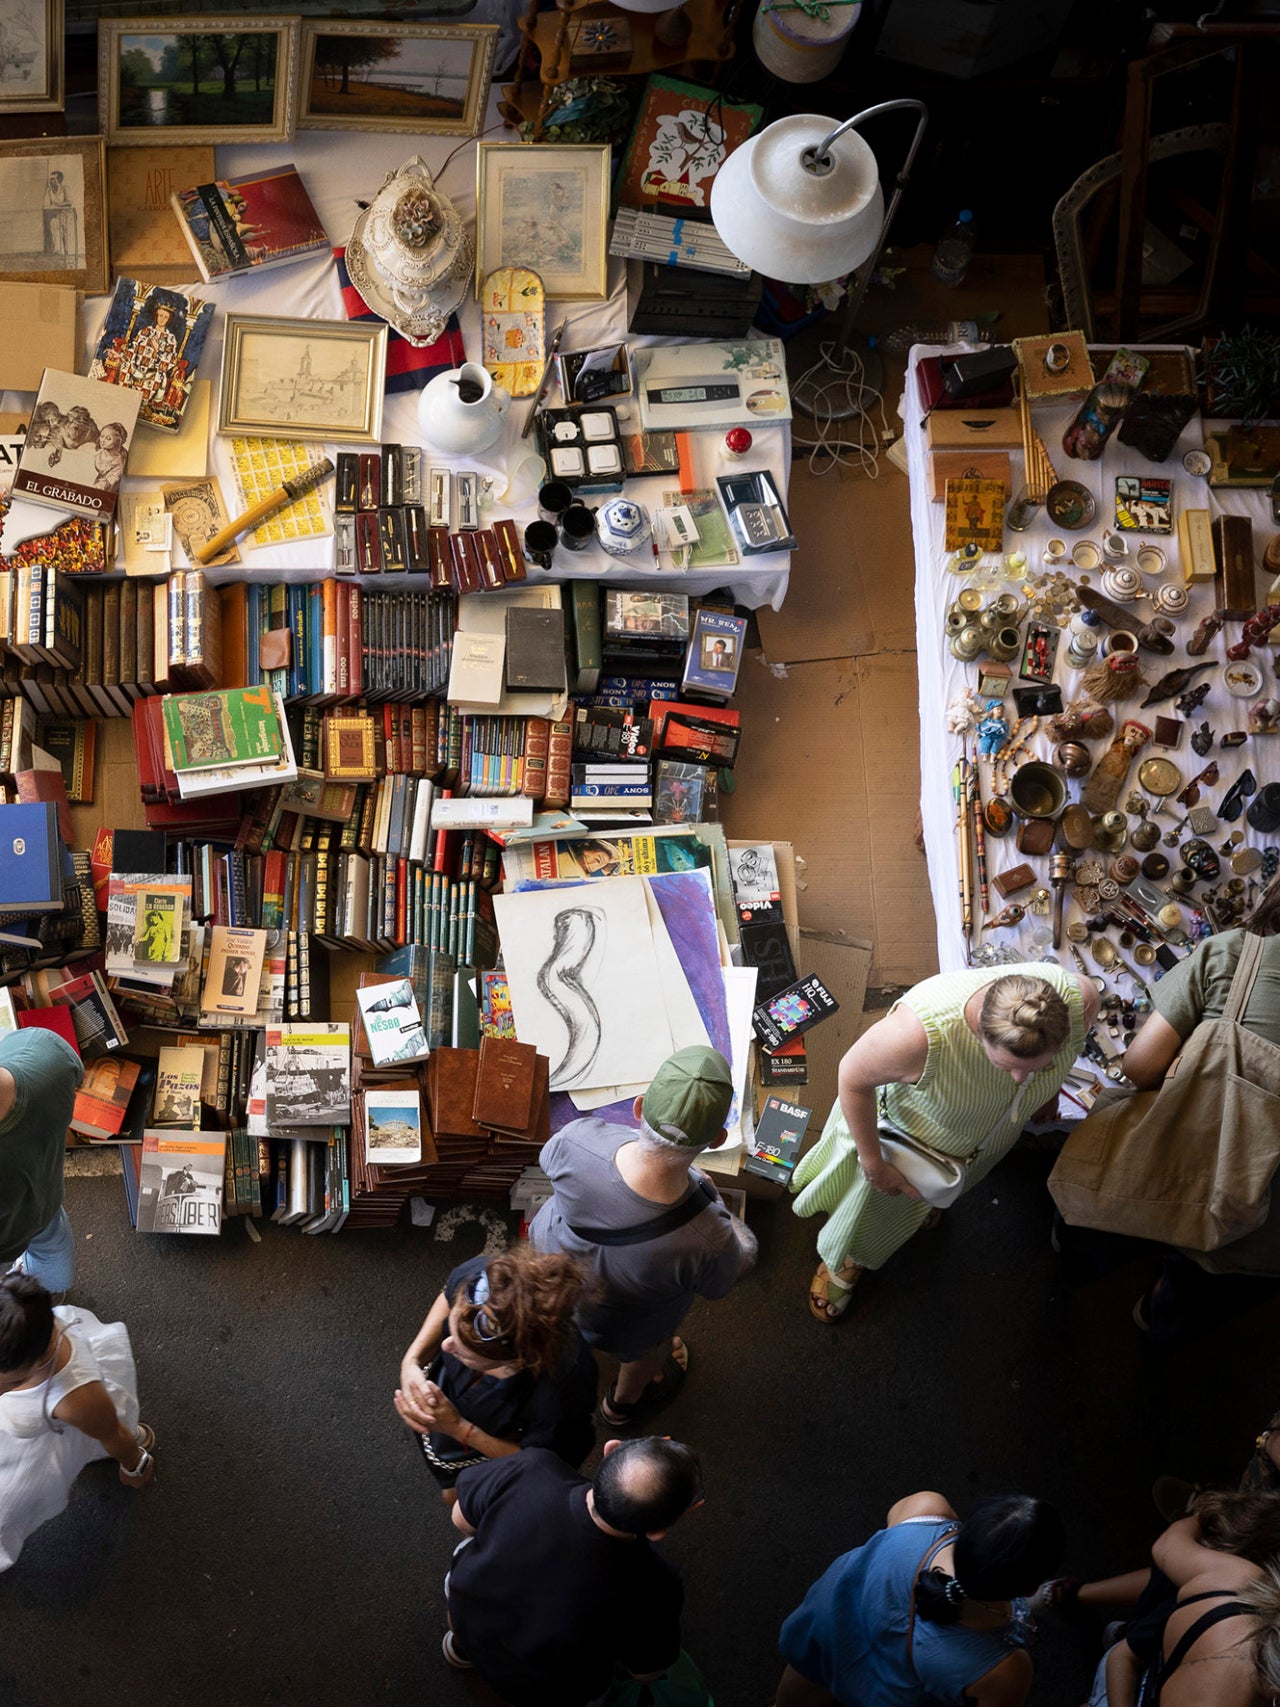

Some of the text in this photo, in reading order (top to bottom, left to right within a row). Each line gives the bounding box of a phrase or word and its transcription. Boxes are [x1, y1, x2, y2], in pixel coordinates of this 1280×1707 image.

[25, 480, 40, 493] EL
[41, 485, 103, 509] GRABADO
[350, 588, 360, 620] cocina
[700, 616, 717, 625] MR.
[339, 655, 348, 690] cocina
[631, 680, 647, 688] 240
[650, 680, 676, 688] SONY
[602, 688, 629, 696] SONY
[631, 689, 648, 698] 240
[628, 724, 641, 756] Video
[603, 786, 620, 797] 240
[623, 786, 650, 794] SONY
[540, 845, 551, 879] ATALAN
[739, 901, 773, 911] Video
[801, 982, 817, 999] HQ
[816, 985, 834, 1007] FUJI
[159, 1071, 179, 1081] Los
[158, 1078, 201, 1093] Pazos
[779, 1102, 809, 1120] BASF
[755, 1141, 782, 1157] E-180
